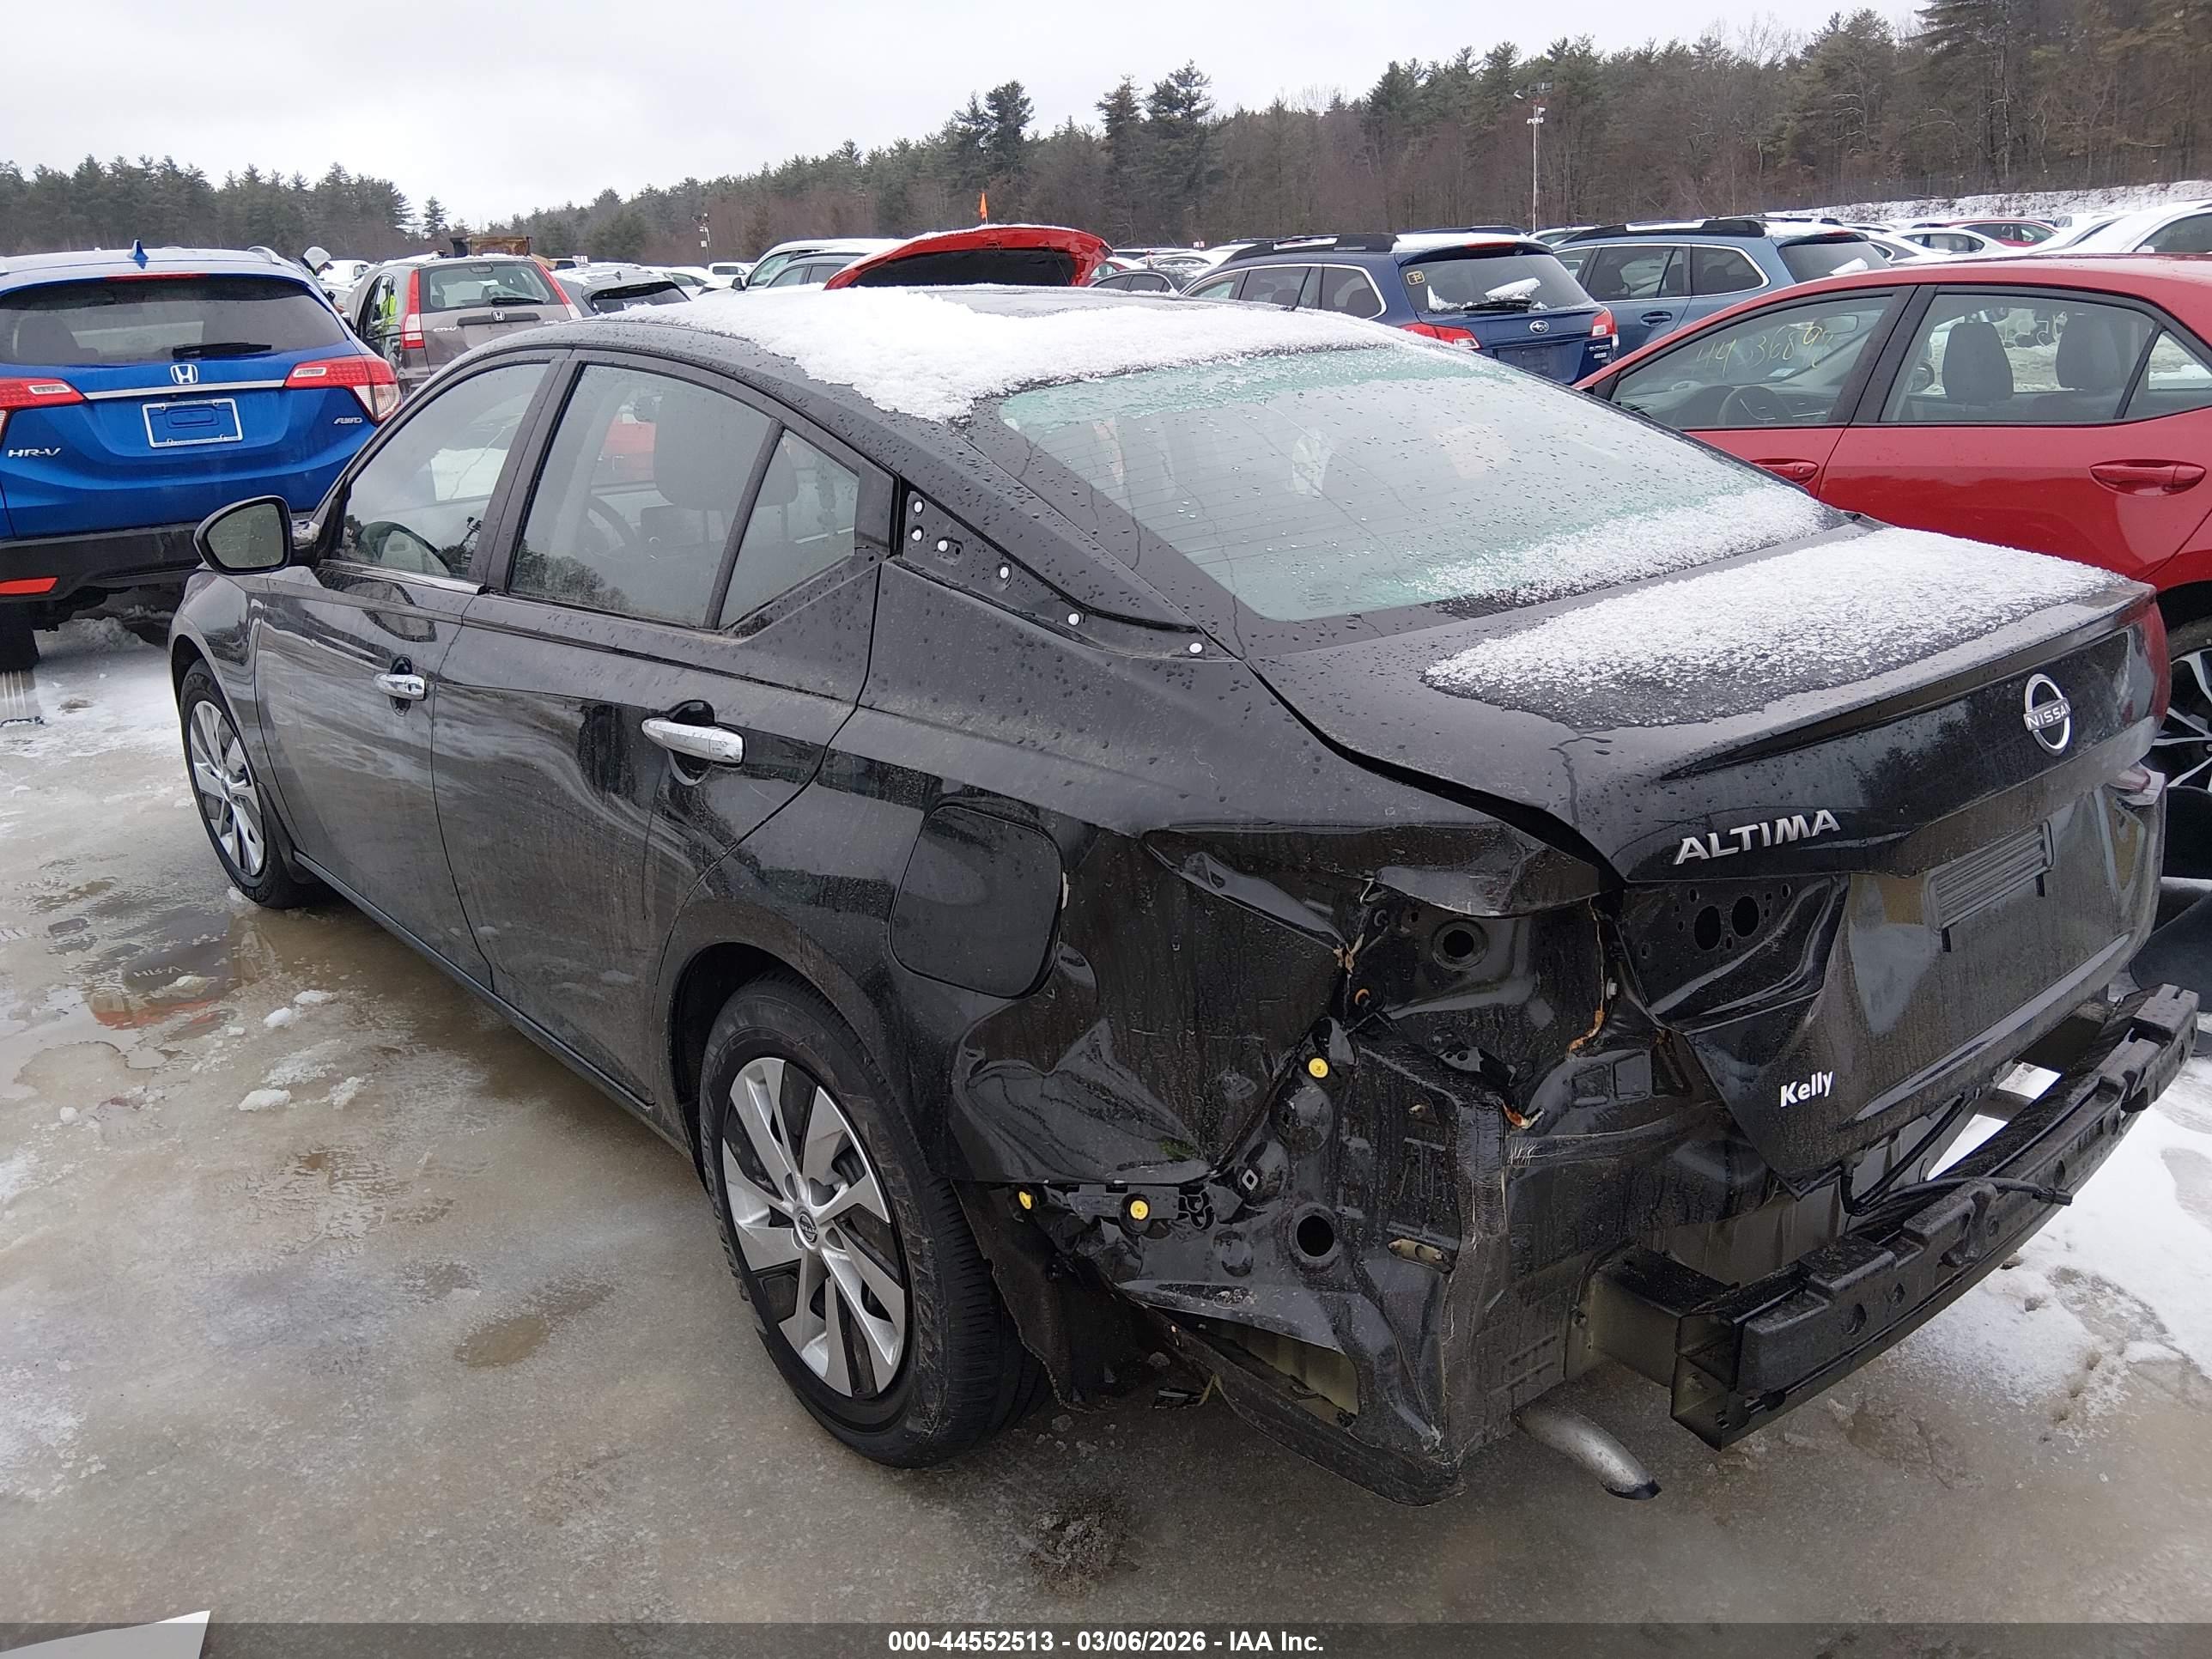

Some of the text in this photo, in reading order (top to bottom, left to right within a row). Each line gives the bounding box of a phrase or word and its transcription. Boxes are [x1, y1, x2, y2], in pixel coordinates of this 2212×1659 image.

[8, 447, 62, 458] HR-V
[2026, 702, 2071, 728] NISSAN
[1673, 809, 1841, 866] ALTIMA
[1780, 1071, 1833, 1108] Kelly
